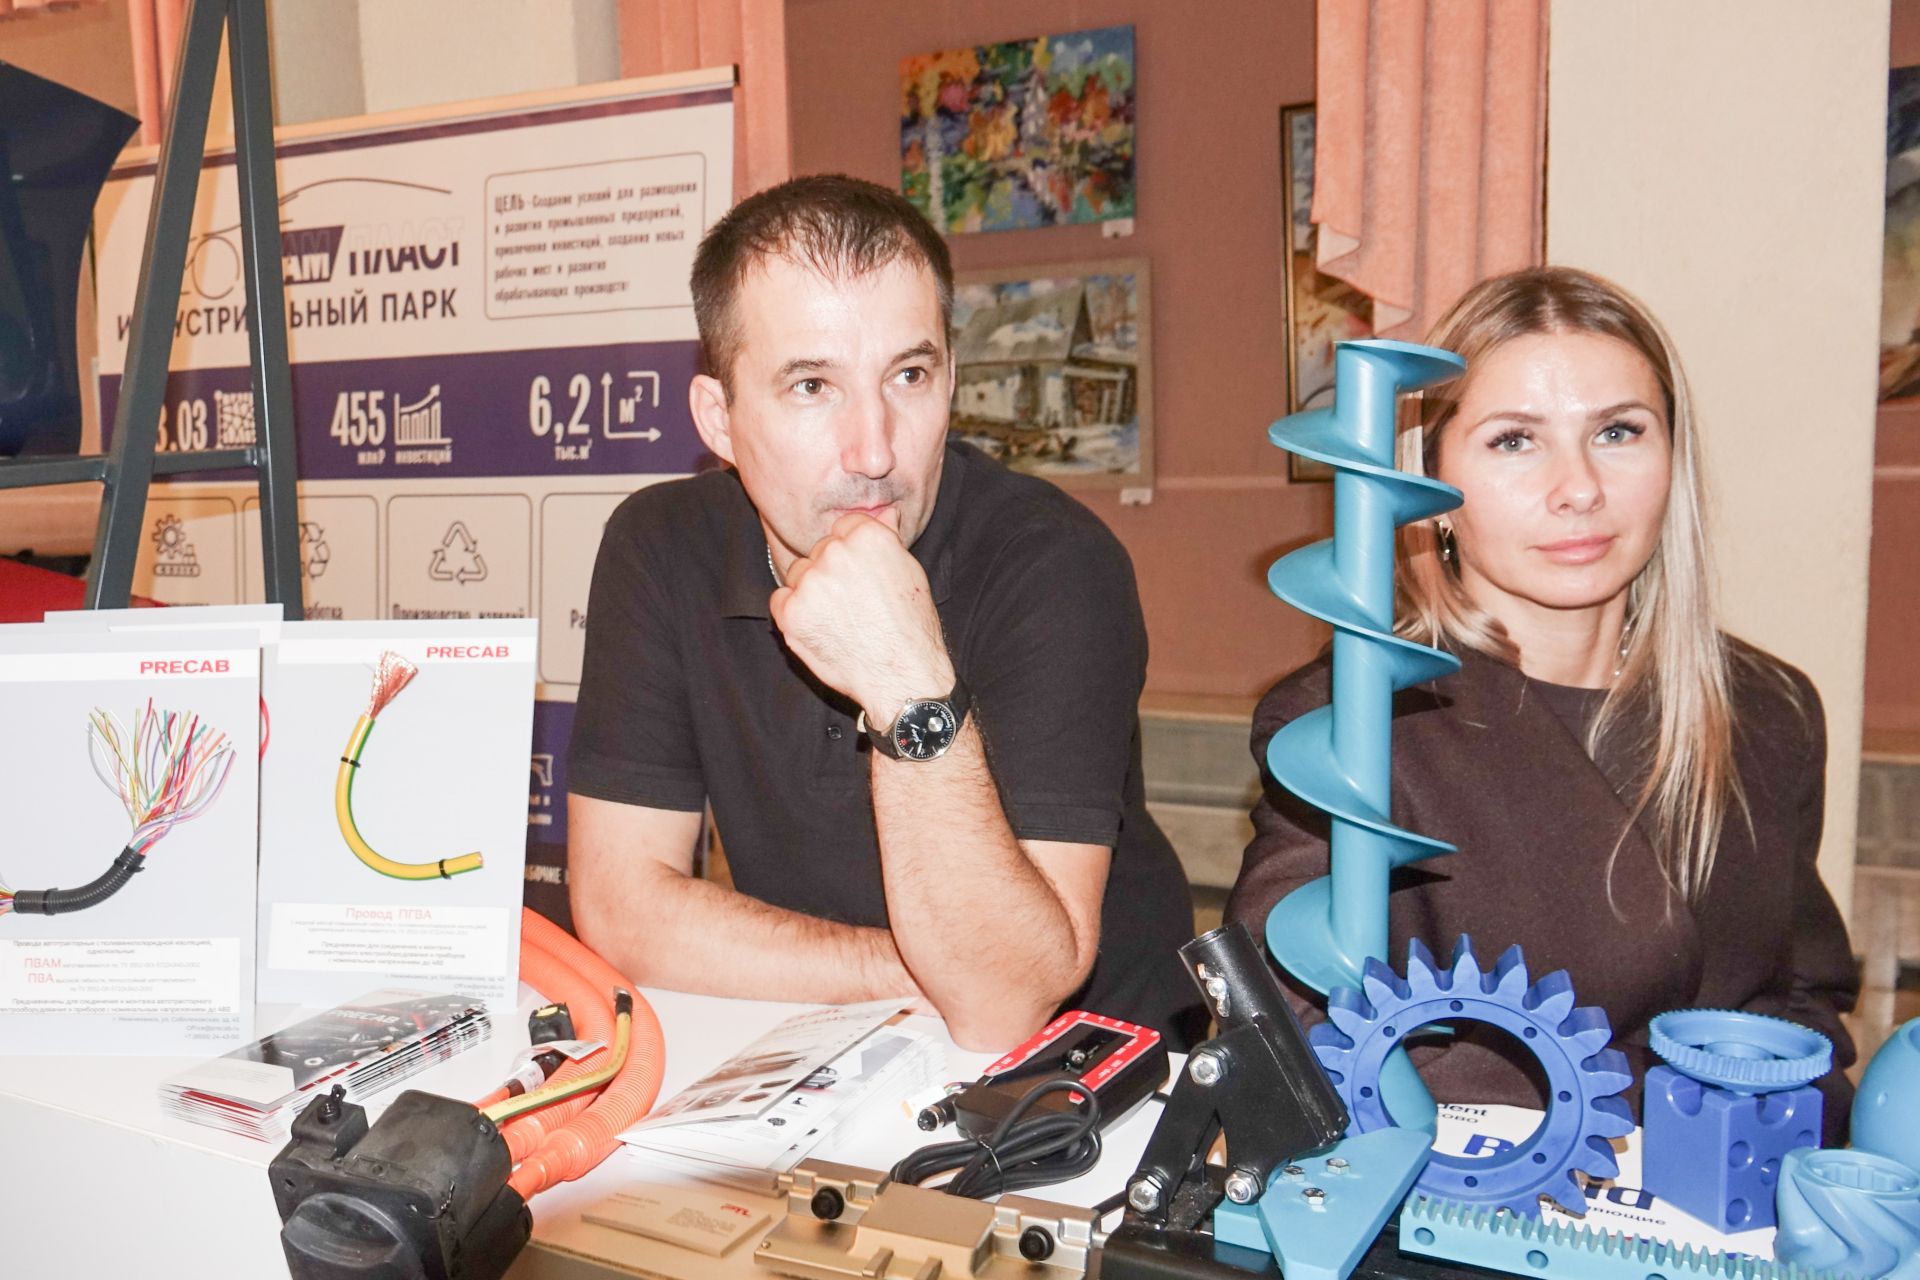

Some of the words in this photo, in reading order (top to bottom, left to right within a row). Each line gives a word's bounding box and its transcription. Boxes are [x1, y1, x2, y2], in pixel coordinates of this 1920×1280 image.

[495, 194, 524, 214] ЦЕЛЬ
[381, 288, 458, 323] ПАРК
[529, 373, 592, 444] 6,2
[330, 389, 387, 447] 455
[427, 645, 510, 659] PRECAB
[139, 659, 231, 675] PRECAB
[346, 907, 393, 921] Провод
[400, 908, 433, 920] ПГВА
[24, 958, 62, 969] ПВАМ
[28, 973, 55, 984] ПВА
